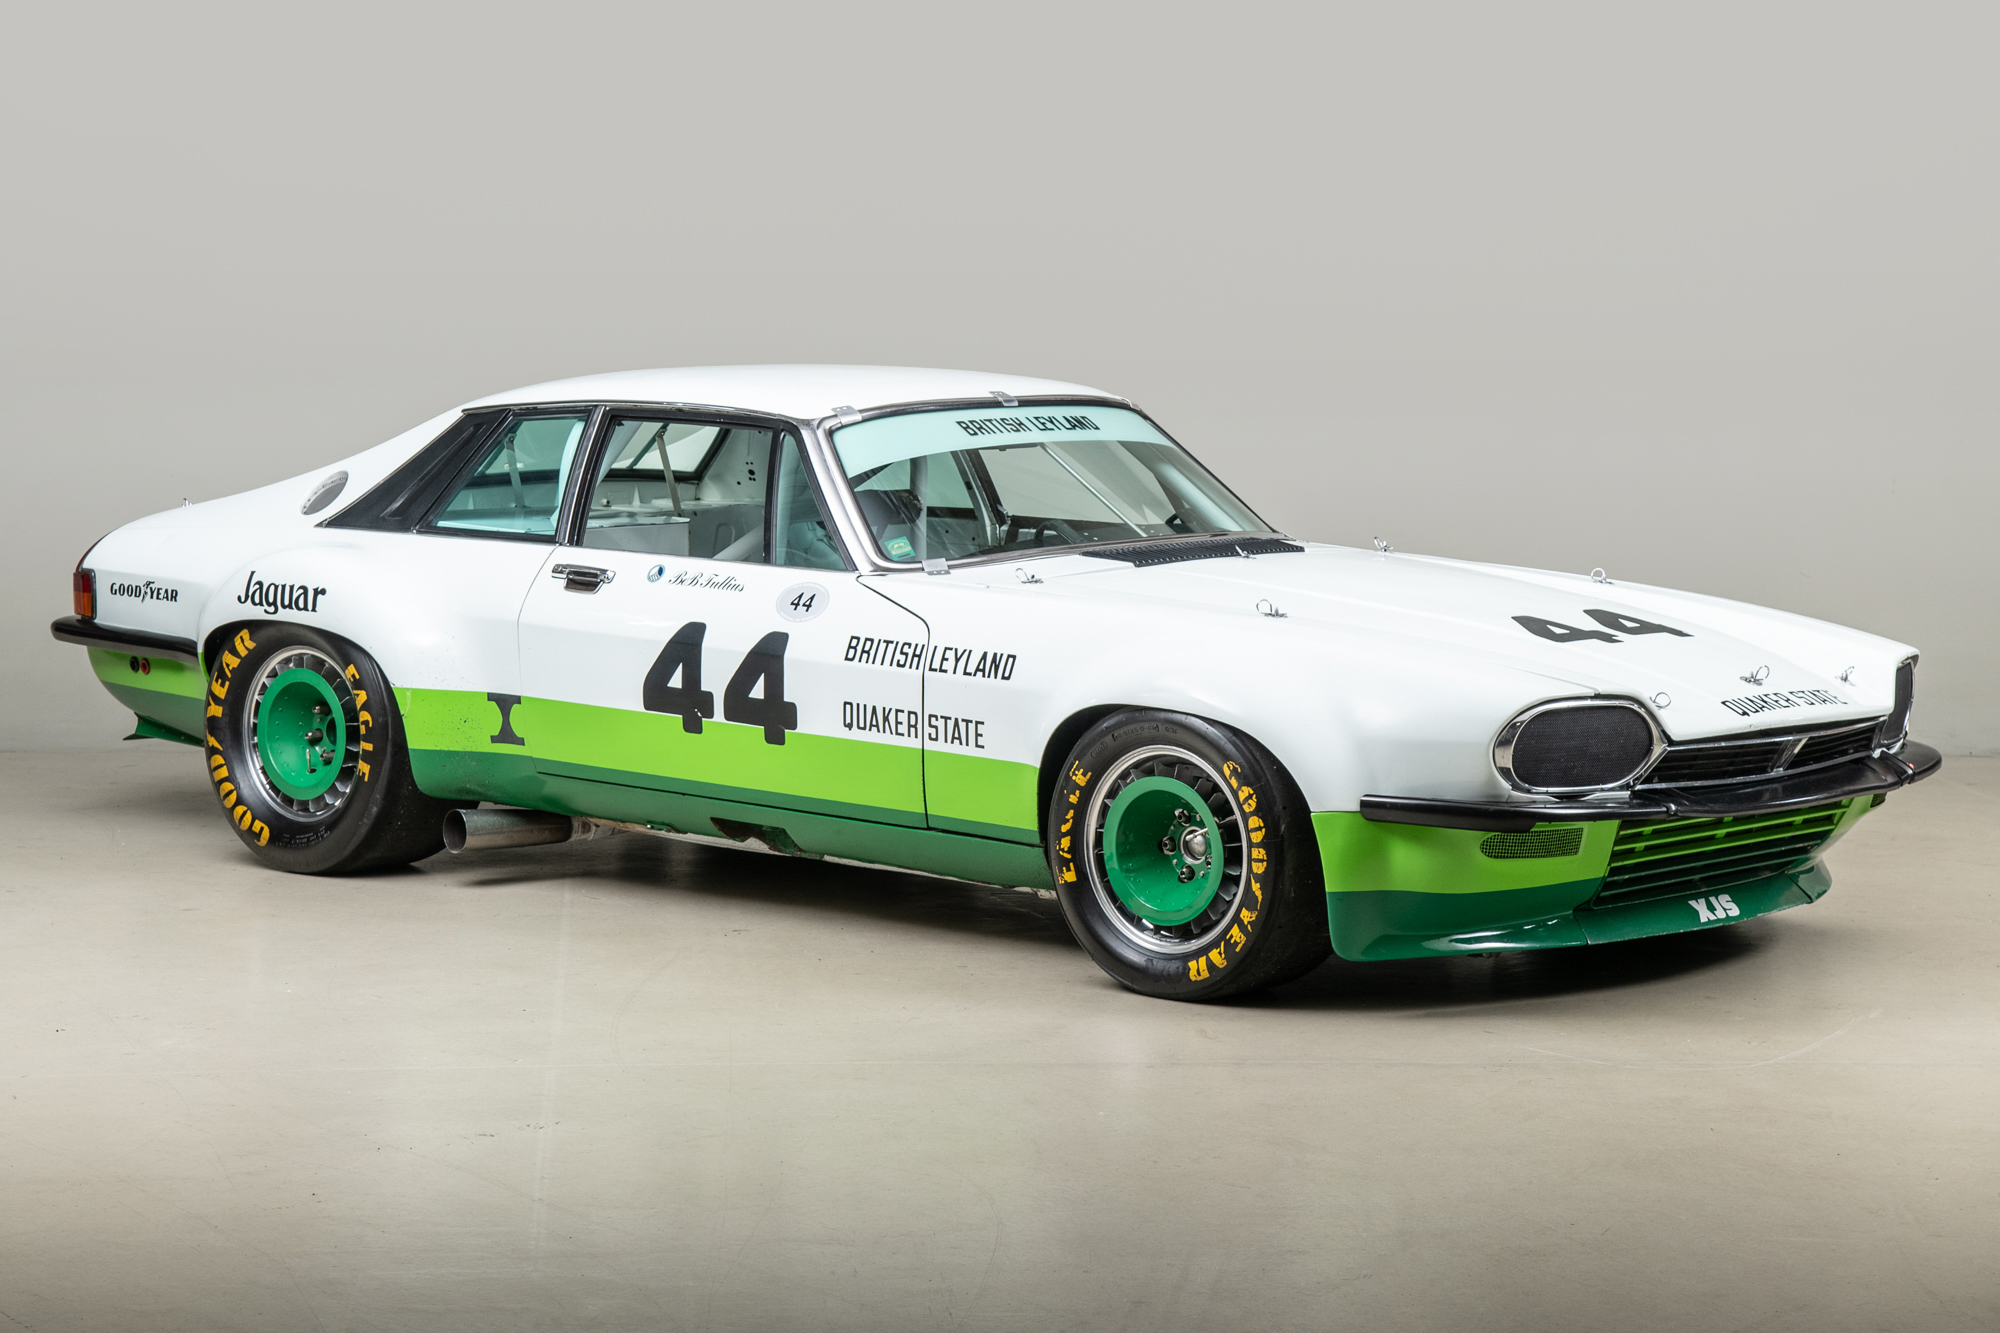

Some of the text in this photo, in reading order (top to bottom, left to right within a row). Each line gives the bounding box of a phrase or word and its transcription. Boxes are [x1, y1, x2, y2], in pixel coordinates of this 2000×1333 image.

[955, 415, 1101, 437] BRITISH LEYLAND
[237, 570, 327, 615] Jaguar
[789, 591, 817, 613] 44
[1511, 609, 1695, 644] 44
[844, 635, 1018, 681] BRITISH LEYLAND
[643, 621, 798, 746] 44
[1720, 689, 1849, 717] QUAKER STATE
[345, 663, 374, 783] EAGLE
[843, 701, 985, 749] QUAKER STATE
[1687, 893, 1741, 923] XJS
